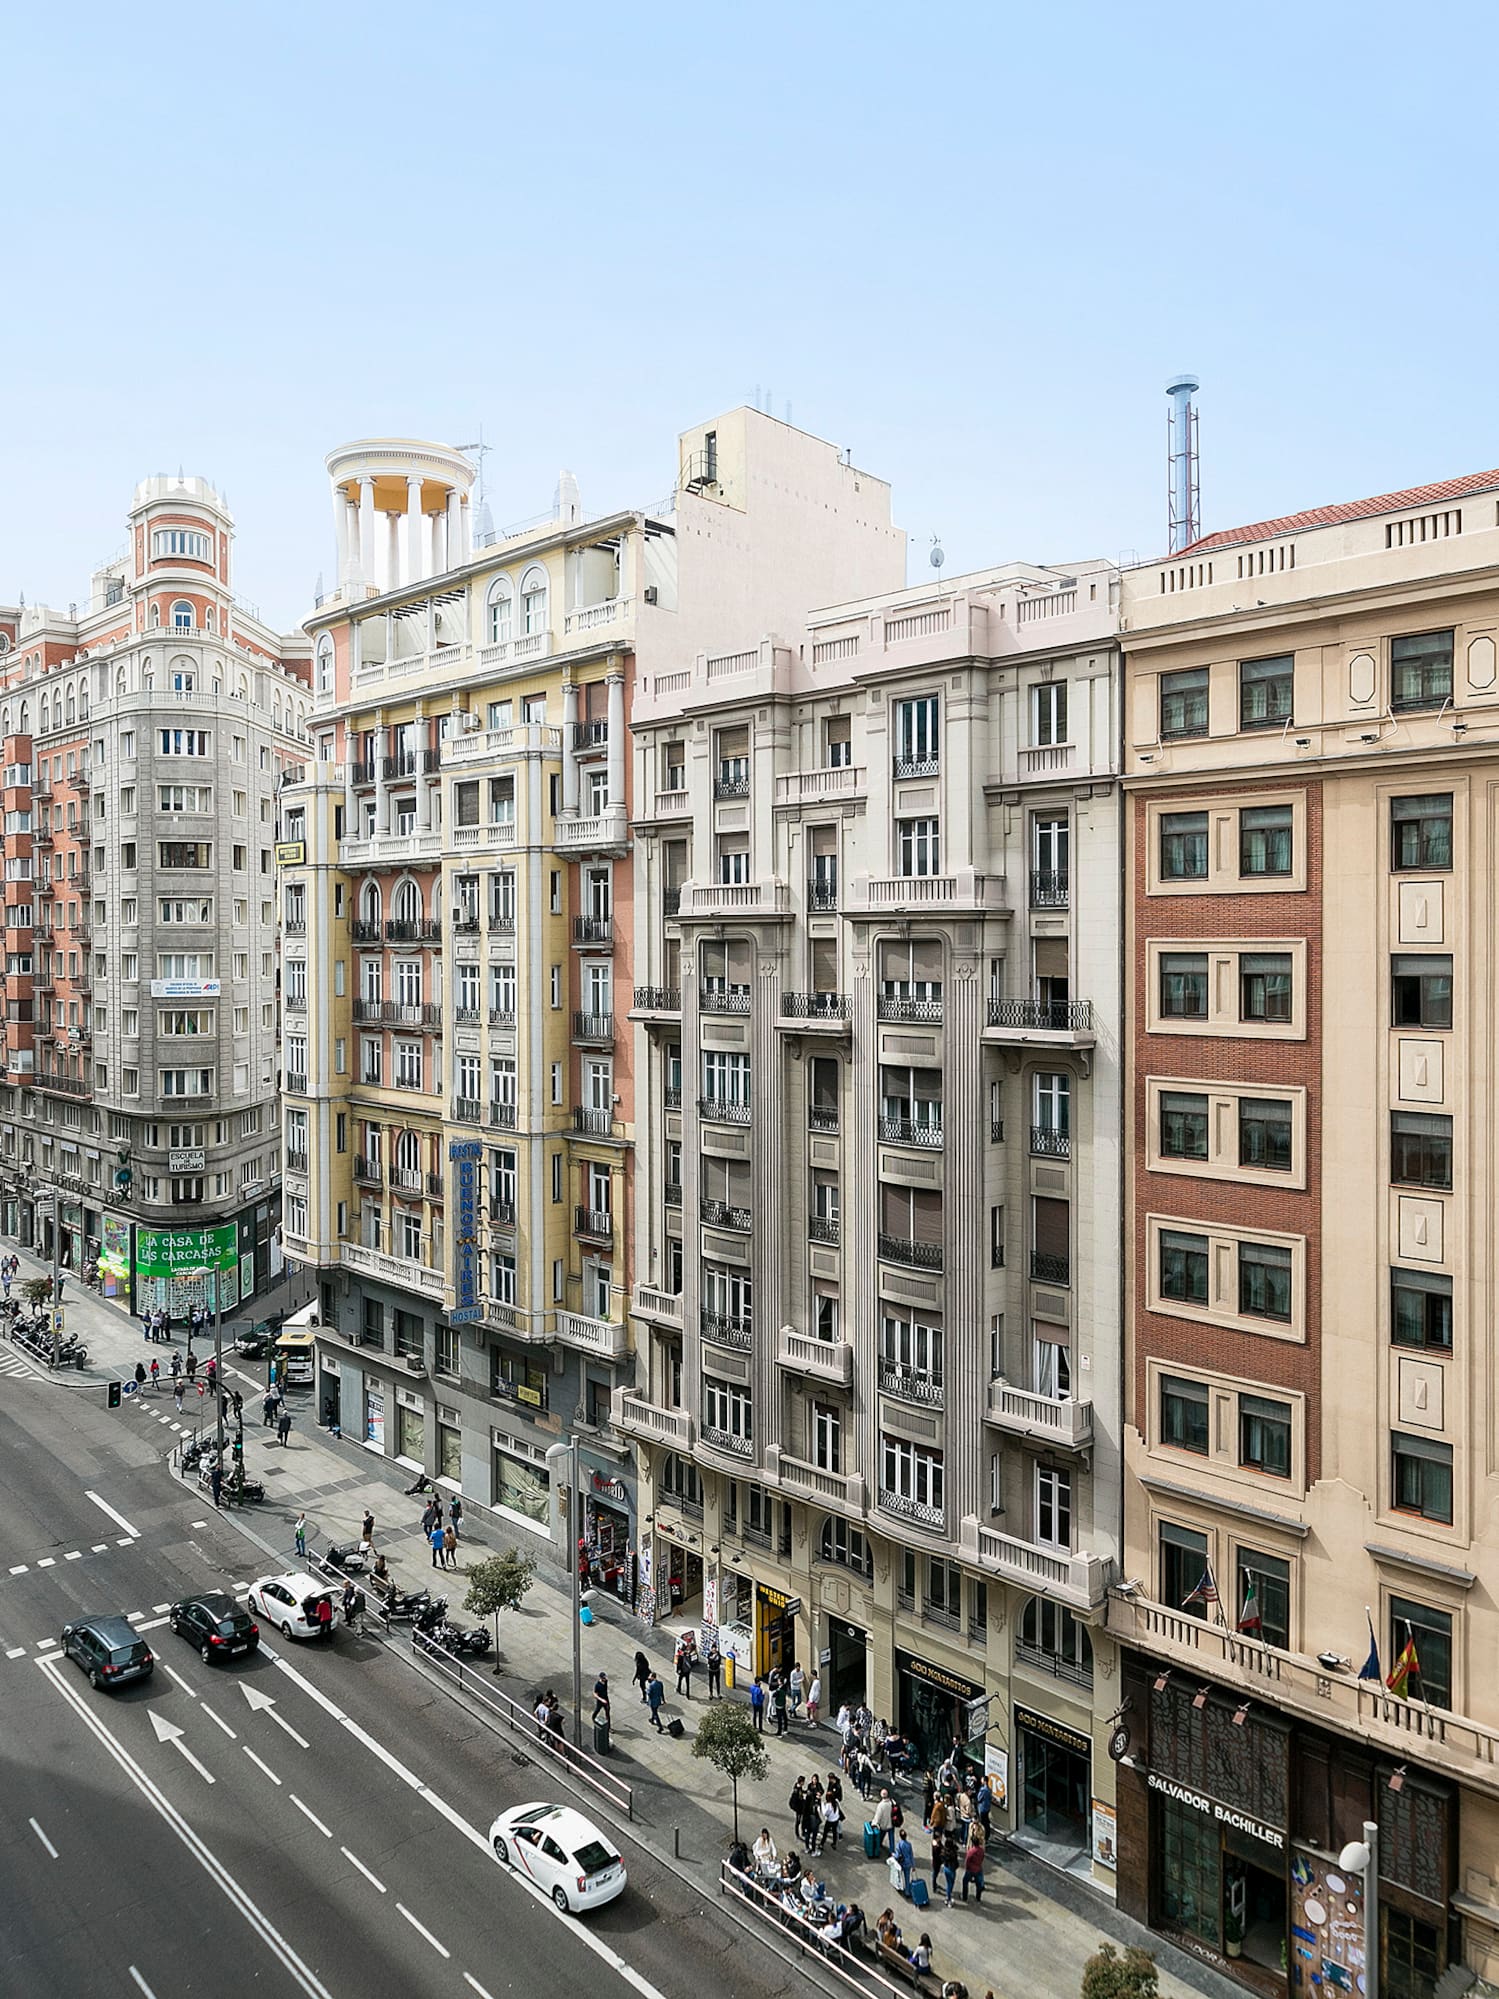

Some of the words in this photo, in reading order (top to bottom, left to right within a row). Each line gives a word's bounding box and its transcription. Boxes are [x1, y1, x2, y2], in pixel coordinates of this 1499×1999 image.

[171, 1151, 204, 1160] ESCUELA
[172, 1162, 204, 1170] TURISMO
[461, 1162, 473, 1238] BUENOS
[145, 1236, 158, 1247] LA
[161, 1236, 193, 1247] CASA
[199, 1233, 215, 1245] DE
[161, 1246, 222, 1260] CARCASAS
[462, 1244, 474, 1307] AIRES
[452, 1310, 482, 1322] HOSTAL
[928, 1668, 971, 1696] MONTADITOS
[1037, 1720, 1088, 1752] MONTADITOS
[1147, 1774, 1211, 1814] SALVADOR
[1214, 1805, 1283, 1849] BACHILLER
